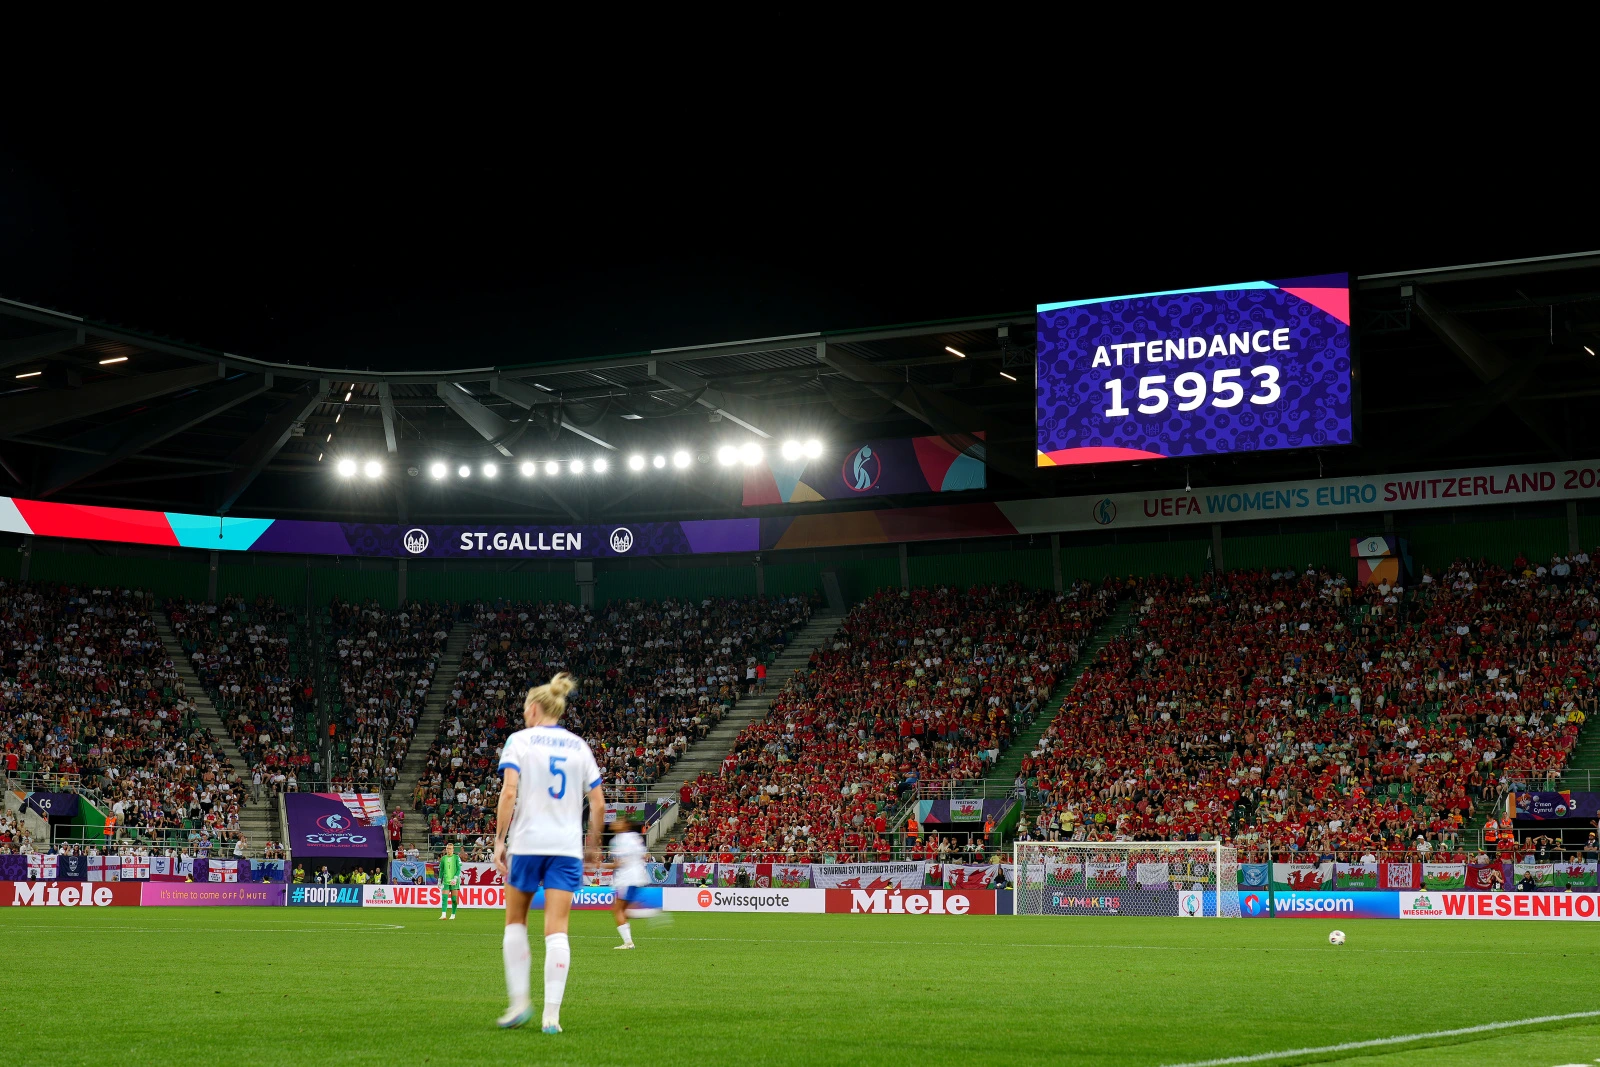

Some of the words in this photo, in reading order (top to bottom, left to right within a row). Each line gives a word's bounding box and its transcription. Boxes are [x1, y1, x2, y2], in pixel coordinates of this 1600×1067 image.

[1092, 328, 1290, 367] ATTENDANCE
[1105, 365, 1281, 417] 15953
[1143, 496, 1201, 517] UEFA
[1206, 487, 1309, 514] WOMEN'S
[1316, 484, 1377, 506] EURO
[1384, 471, 1556, 502] SWITZERLAND
[1563, 468, 1600, 490] 20
[460, 532, 582, 551] ST.GALLEN
[548, 755, 568, 800] 5
[39, 798, 52, 809] C6
[889, 864, 918, 874] GYRCHFAN
[12, 882, 113, 906] Miele
[160, 890, 171, 899] It's
[172, 890, 189, 899] time
[190, 890, 198, 899] to
[246, 892, 267, 900] MUTE
[714, 891, 790, 910] Swissquote
[850, 889, 970, 915] Miele
[1052, 896, 1121, 908] PLAYMAKERS
[1442, 894, 1600, 917] WIESENHO
